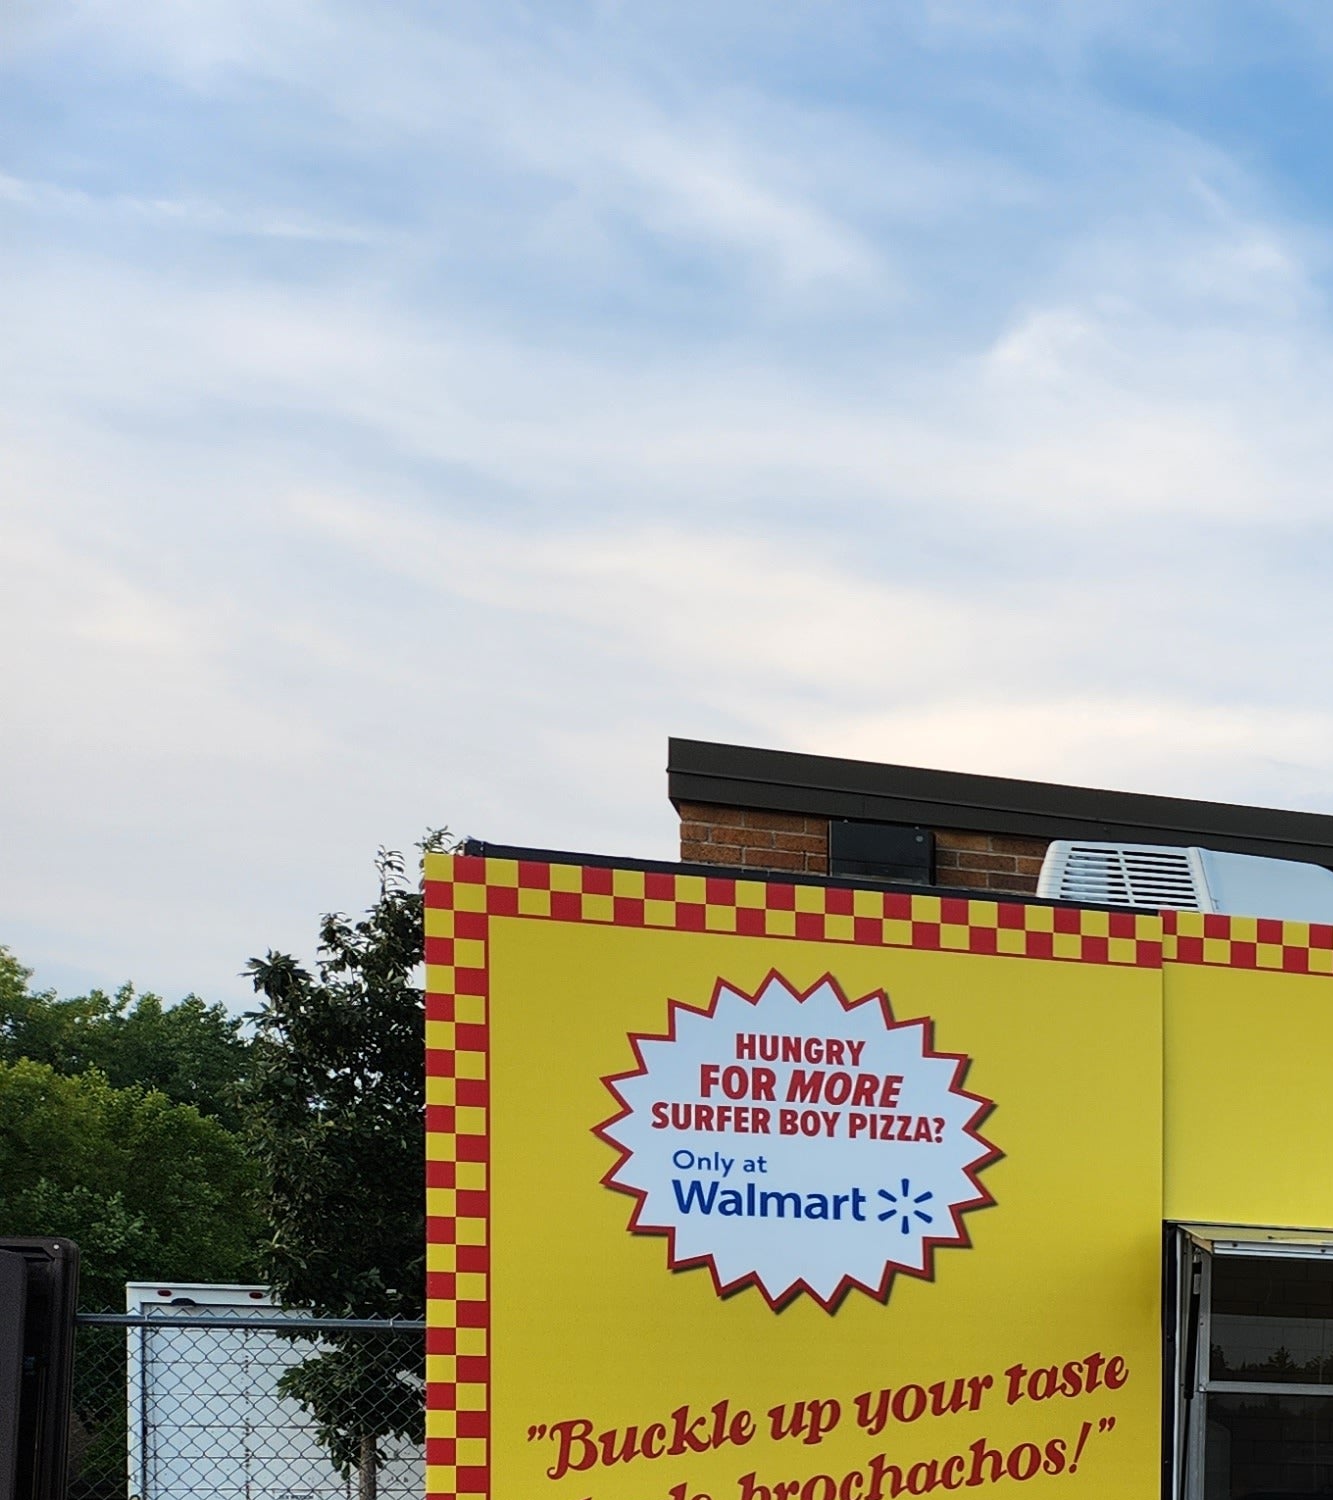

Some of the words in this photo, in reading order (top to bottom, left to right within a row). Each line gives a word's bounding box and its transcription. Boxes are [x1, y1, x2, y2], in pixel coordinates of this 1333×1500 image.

[736, 1033, 866, 1067] HUNGRY
[700, 1064, 777, 1101] FOR
[786, 1069, 904, 1109] MORE
[651, 1101, 771, 1135] SURFER
[779, 1108, 841, 1139] BOY
[848, 1113, 946, 1144] PIZZA?
[672, 1149, 735, 1178] Only
[743, 1154, 768, 1173] at
[672, 1179, 866, 1222] Walmart
[767, 1397, 841, 1446] up
[854, 1374, 995, 1436] your
[1004, 1351, 1131, 1406] taste
